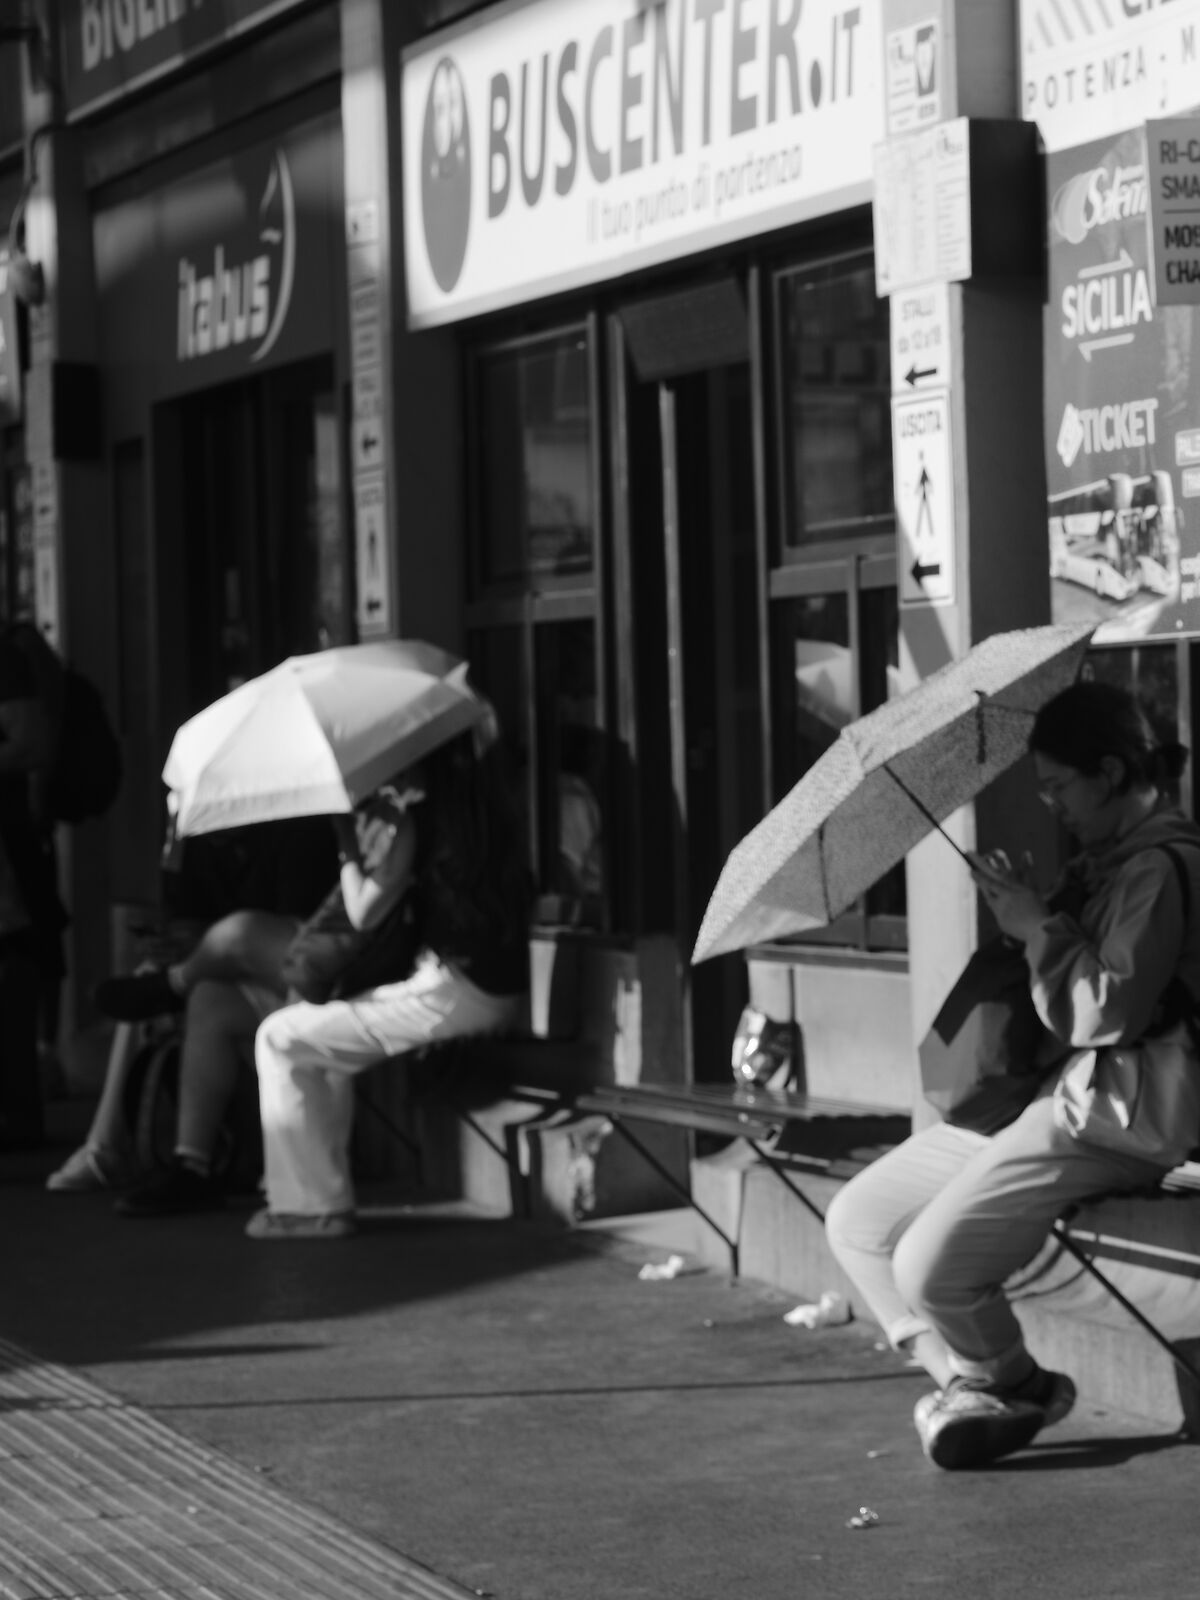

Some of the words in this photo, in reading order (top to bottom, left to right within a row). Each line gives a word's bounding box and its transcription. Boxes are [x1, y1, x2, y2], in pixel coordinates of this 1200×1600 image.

[488, 0, 861, 220] BUSCENTER.IT
[1025, 45, 1147, 112] POTENZA
[177, 244, 271, 361] itabus
[1061, 269, 1153, 338] SICILIA
[1080, 397, 1159, 454] TICKET
